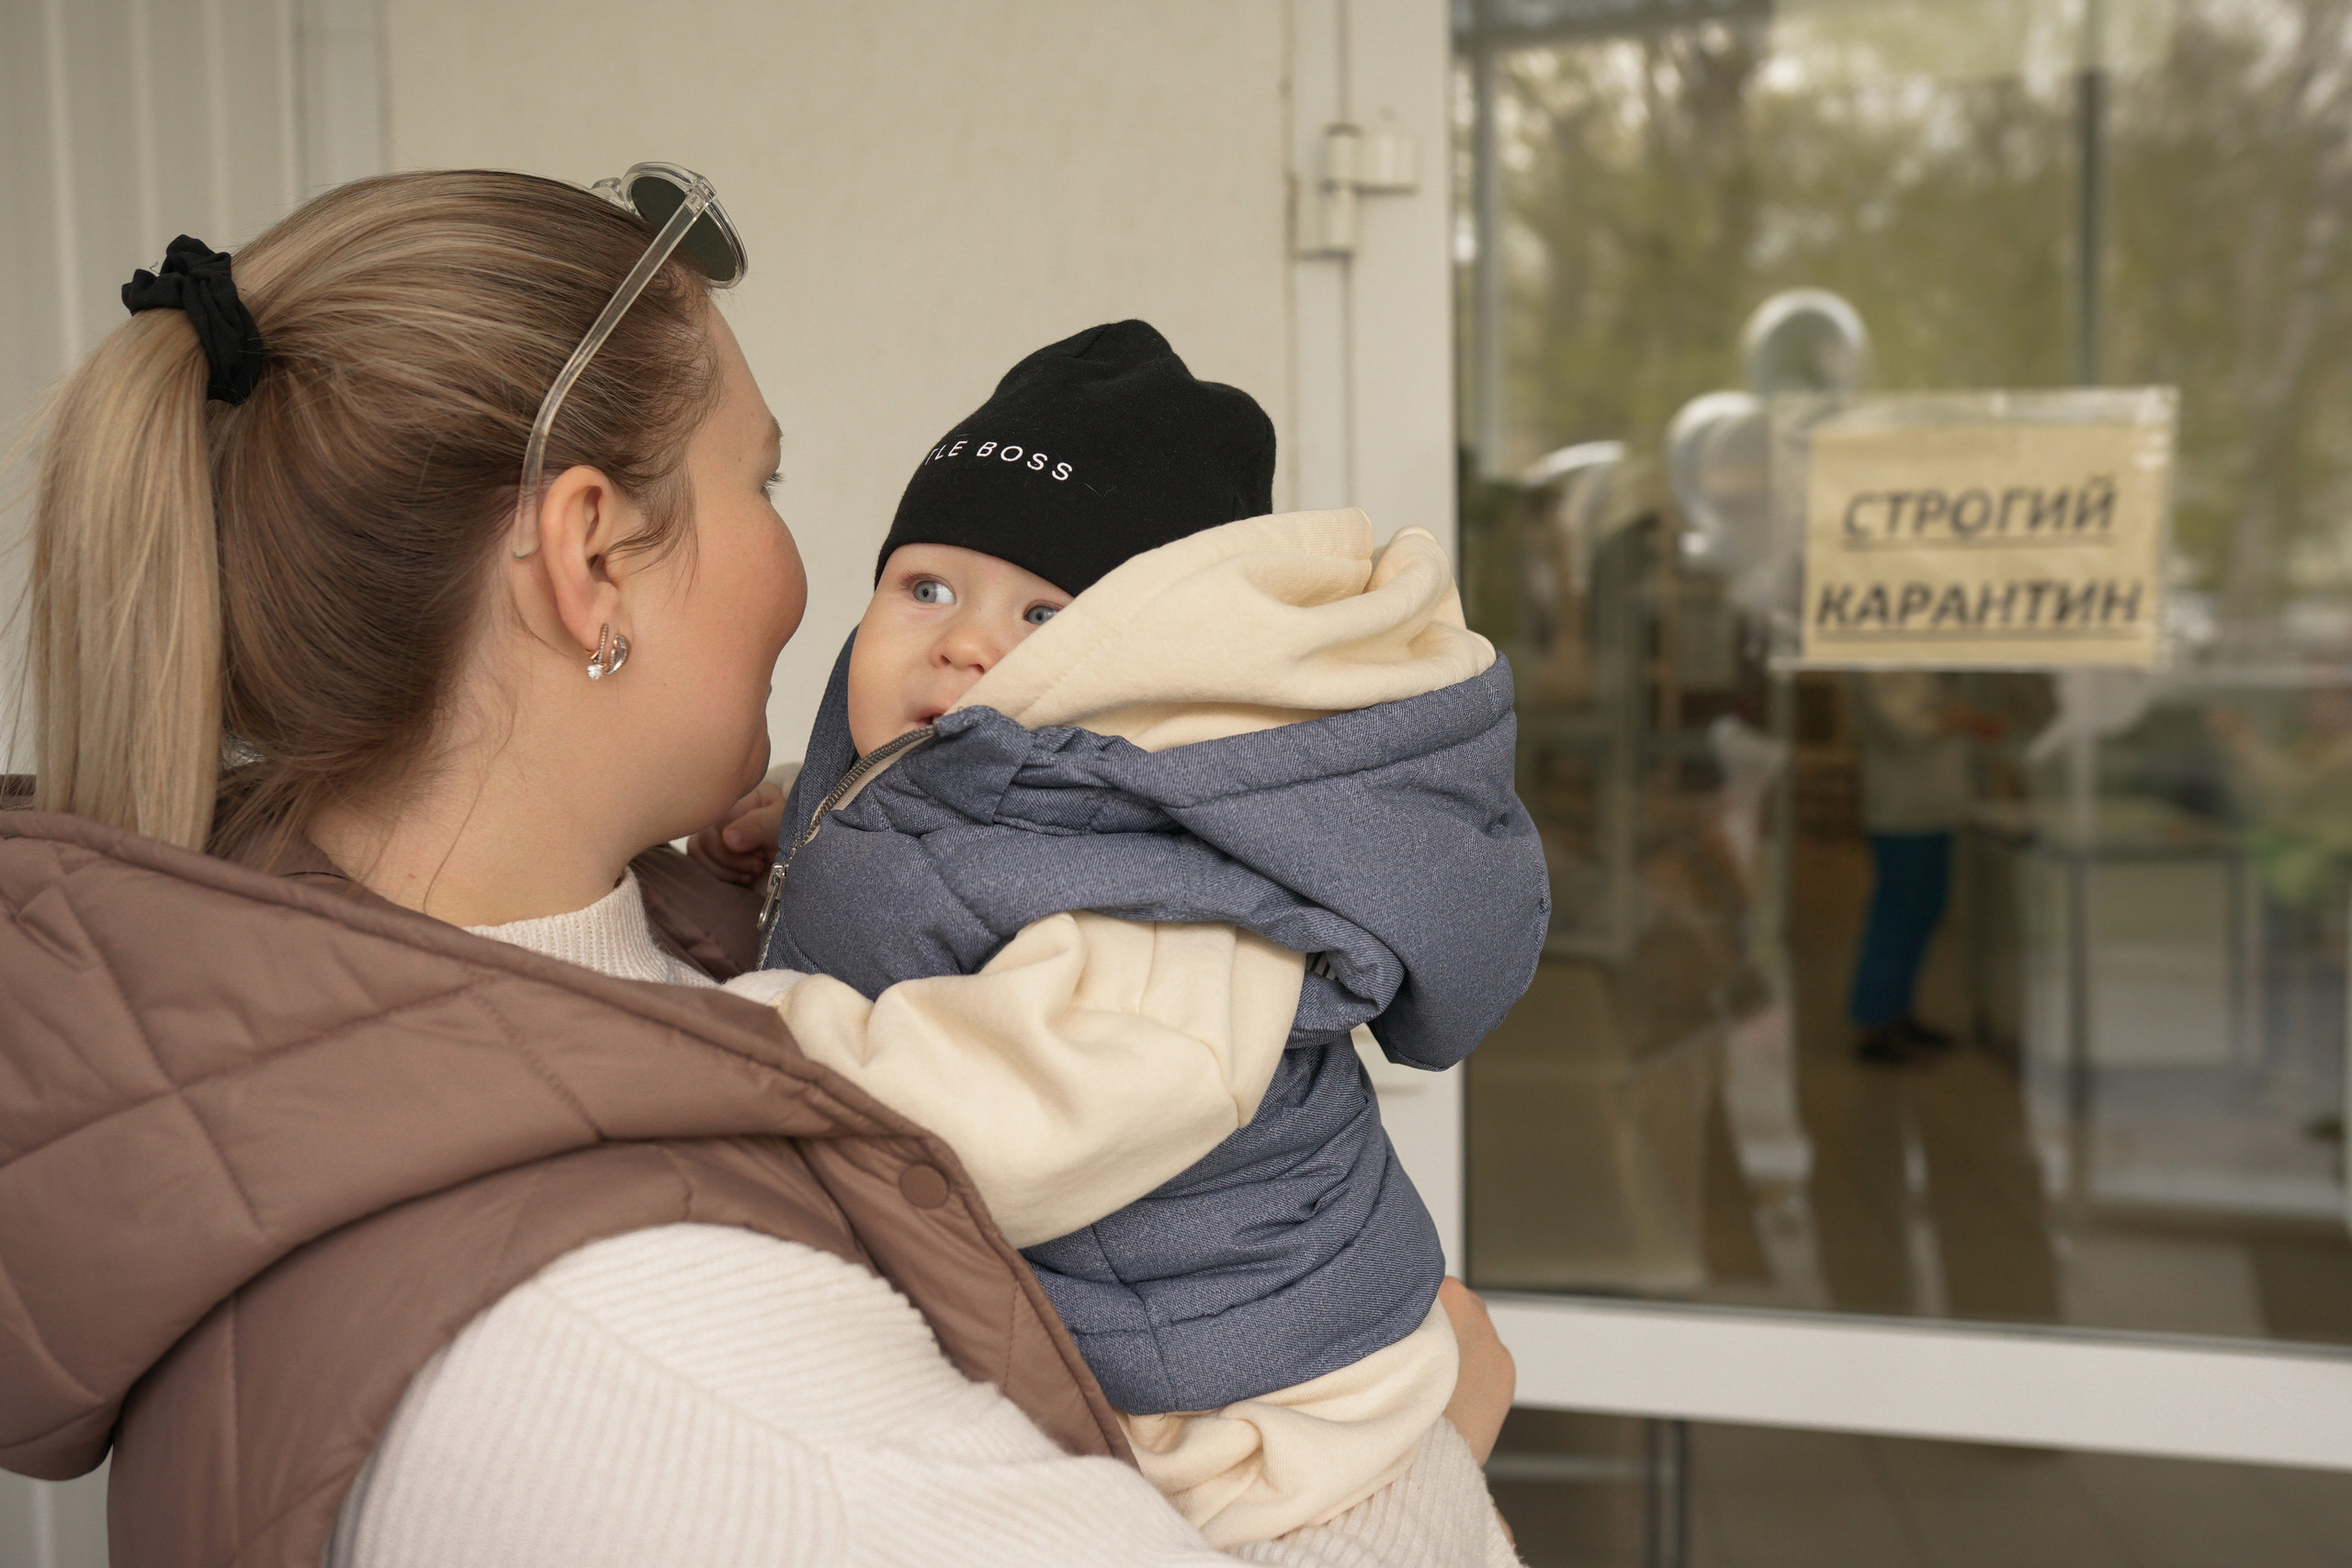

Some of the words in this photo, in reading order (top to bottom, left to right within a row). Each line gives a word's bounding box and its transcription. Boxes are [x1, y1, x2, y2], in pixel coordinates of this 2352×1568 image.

[976, 441, 1073, 481] BOSS
[1843, 475, 2118, 538] СТРОГИЙ
[1816, 579, 2143, 626] КАРАНТИН
